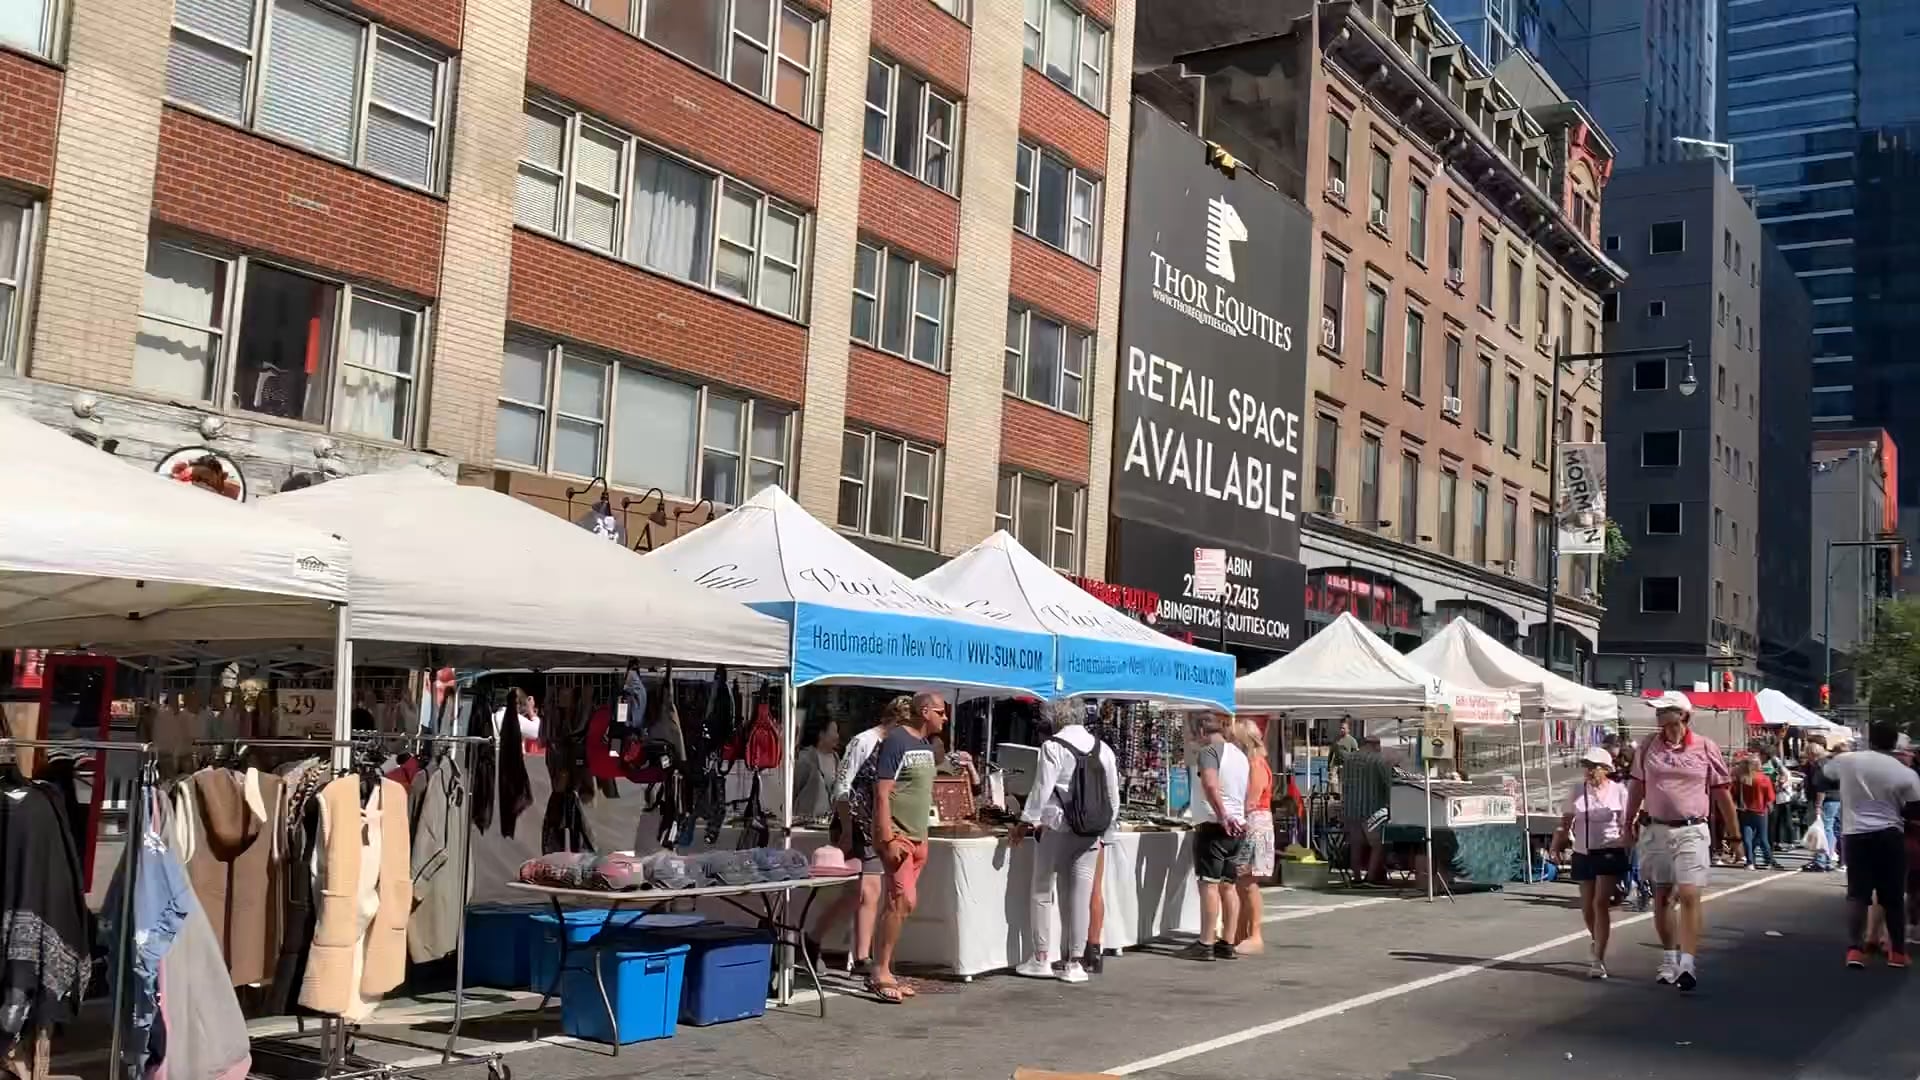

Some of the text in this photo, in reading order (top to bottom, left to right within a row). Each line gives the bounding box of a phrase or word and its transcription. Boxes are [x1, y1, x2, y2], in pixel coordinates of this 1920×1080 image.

[1150, 251, 1292, 351] THOR EQUITIES
[1152, 288, 1237, 337] WWW.THOREQUITIES.COM
[1128, 345, 1299, 454] RETAIL SPACE
[1124, 416, 1297, 522] AVAILABLE
[1563, 450, 1601, 543] MORMN
[1226, 556, 1252, 578] ABIN
[812, 624, 1043, 673] Handmade in New York VIVI-SUN.COM
